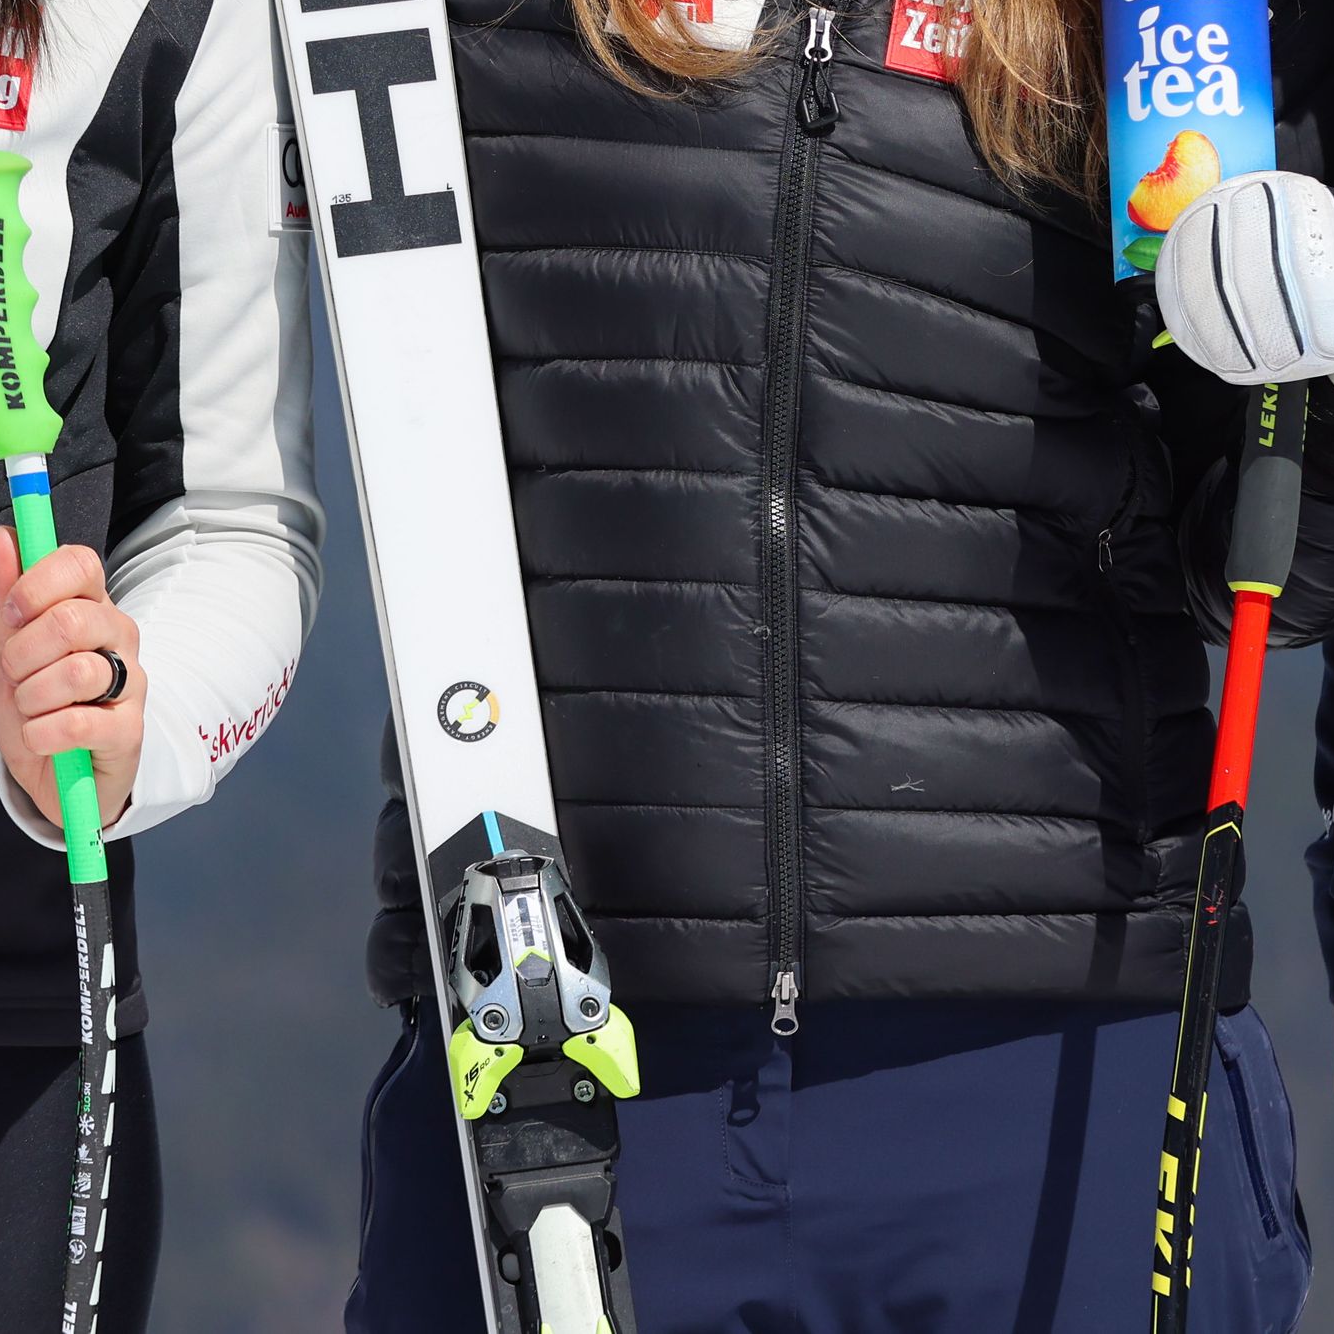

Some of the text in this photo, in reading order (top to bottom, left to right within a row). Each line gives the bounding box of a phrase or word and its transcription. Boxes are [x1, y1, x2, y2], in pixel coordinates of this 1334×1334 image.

[1138, 6, 1229, 67] ice
[1124, 61, 1244, 122] tea
[74, 904, 93, 1045] KOMPERDELL
